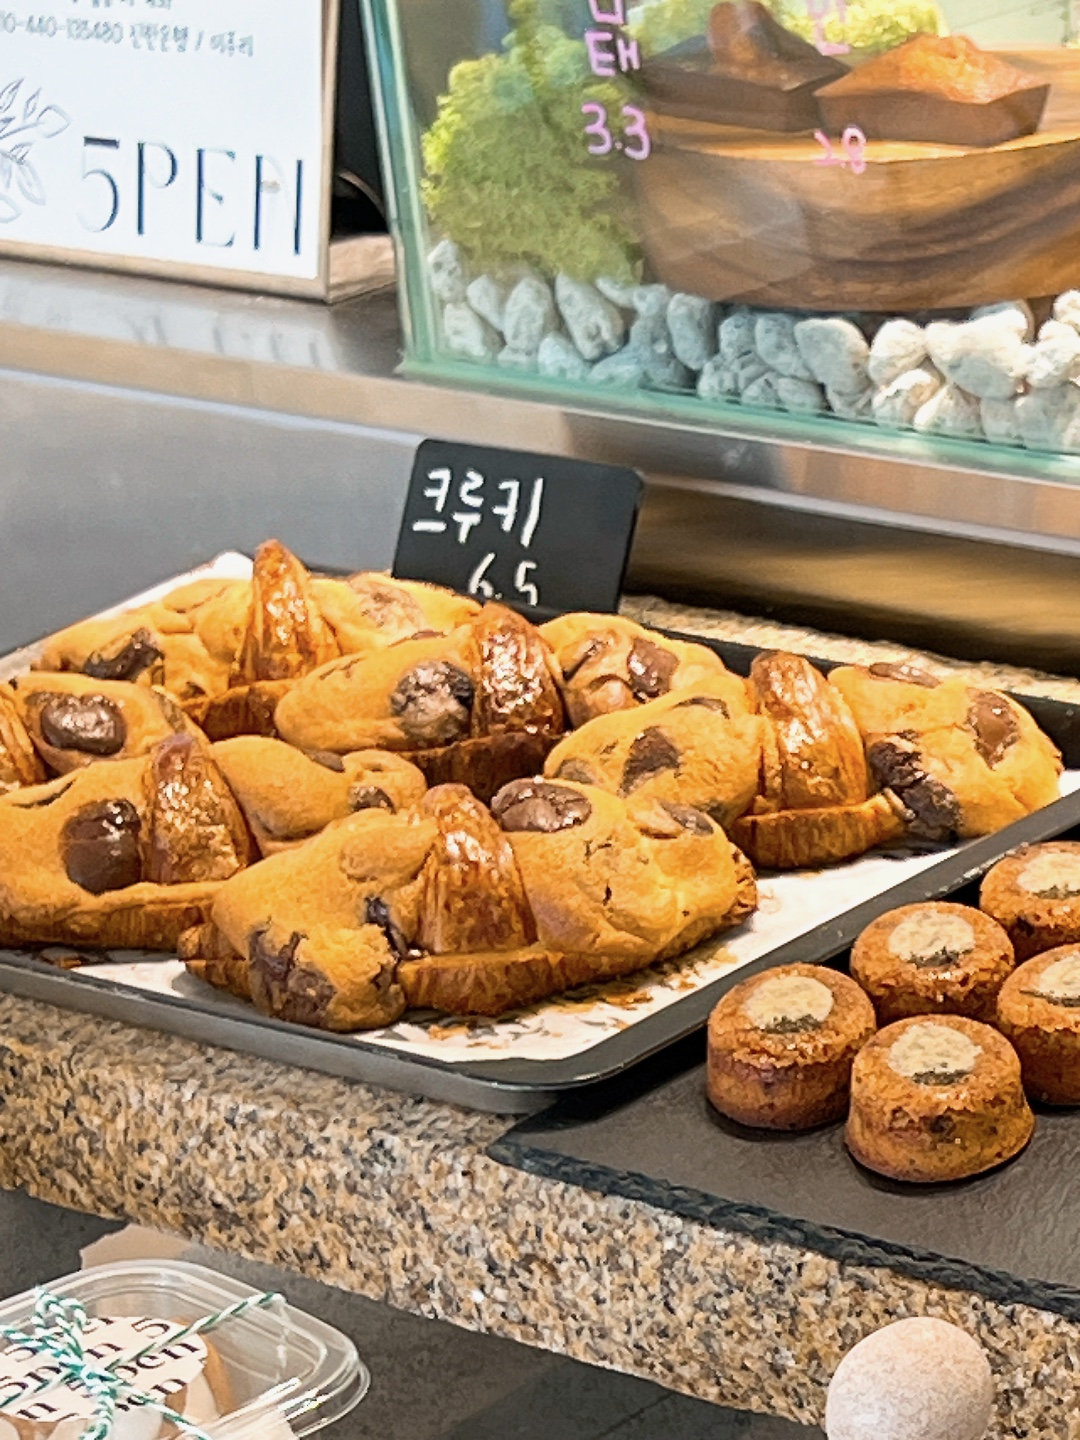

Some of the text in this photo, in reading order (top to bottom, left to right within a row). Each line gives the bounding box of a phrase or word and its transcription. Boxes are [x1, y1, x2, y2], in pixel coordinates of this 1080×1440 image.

[581, 102, 650, 161] 3.3
[412, 467, 545, 548] 크루키
[468, 552, 539, 607] 6.5
